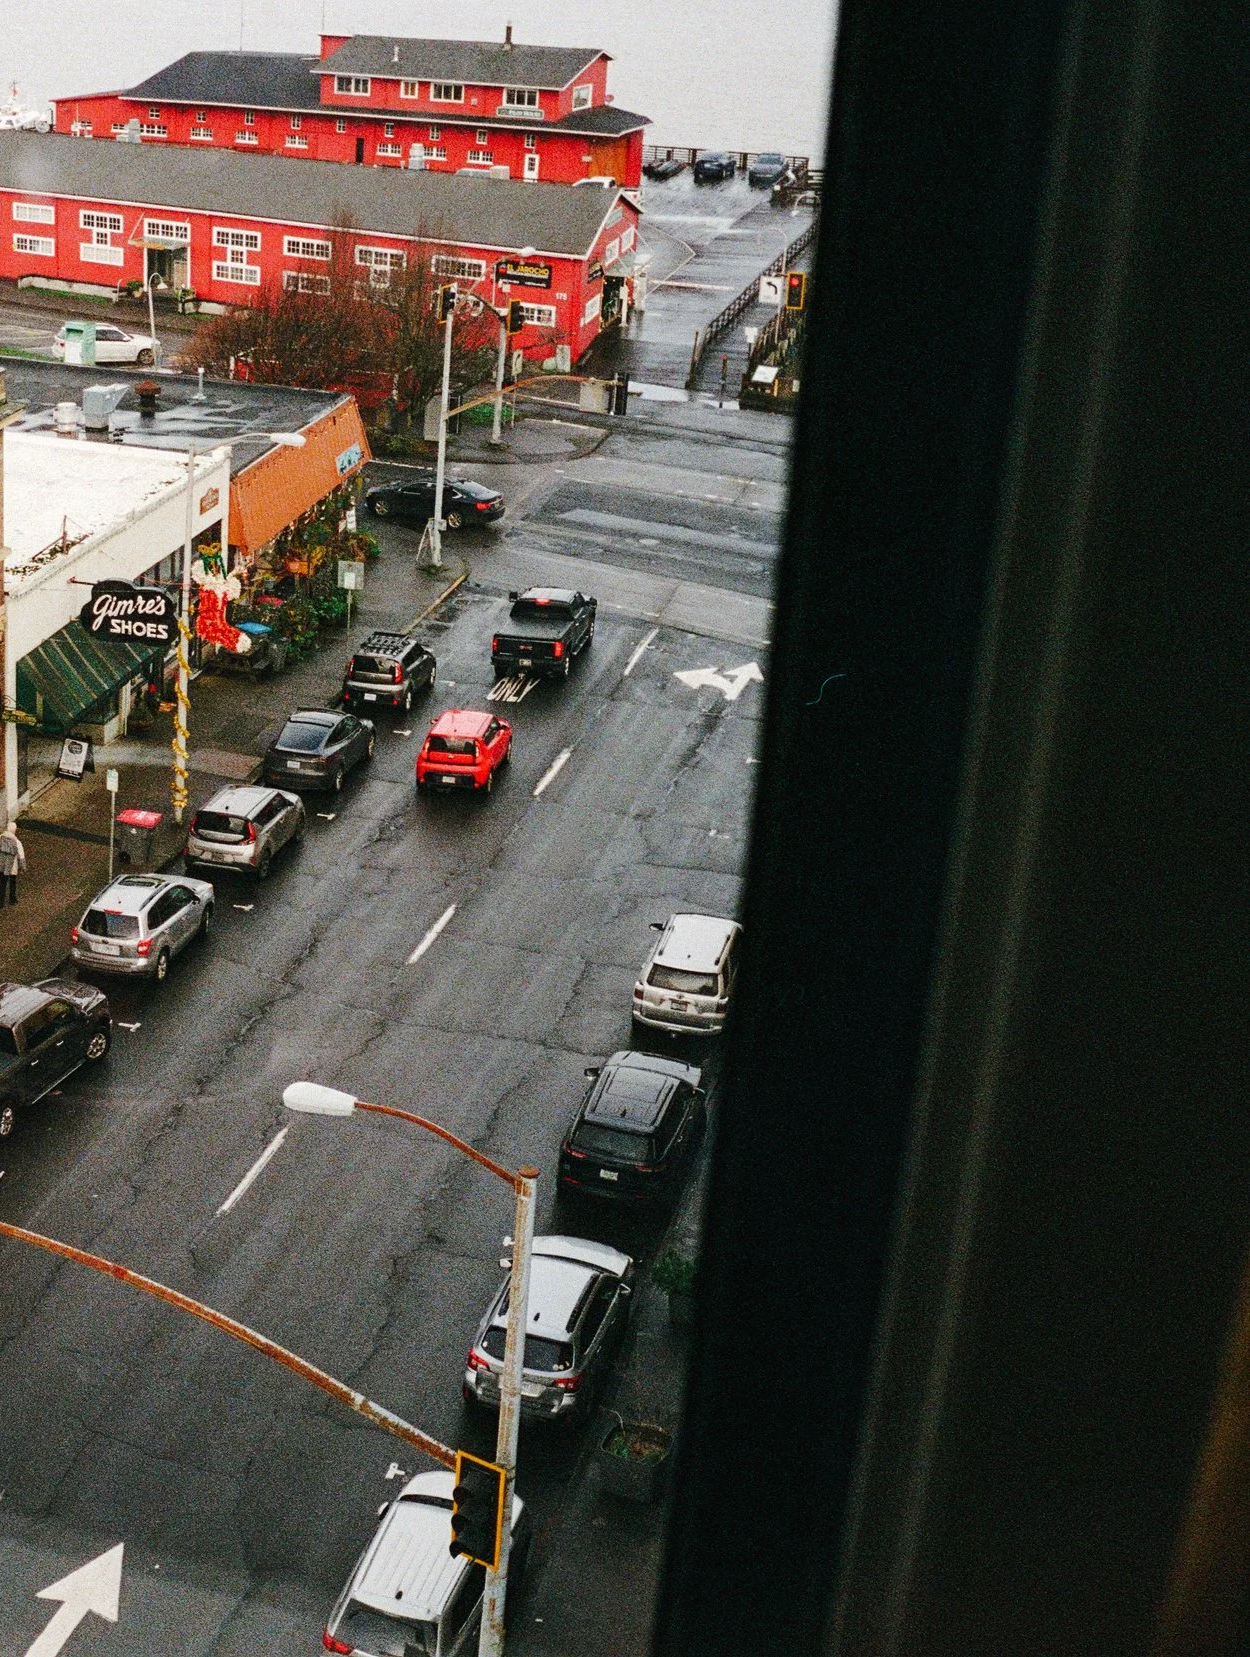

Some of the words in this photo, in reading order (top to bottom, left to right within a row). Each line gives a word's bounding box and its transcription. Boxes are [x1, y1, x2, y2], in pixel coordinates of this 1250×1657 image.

[92, 594, 166, 631] Gimre's
[109, 618, 169, 640] SHOES
[486, 677, 541, 703] ONLY
